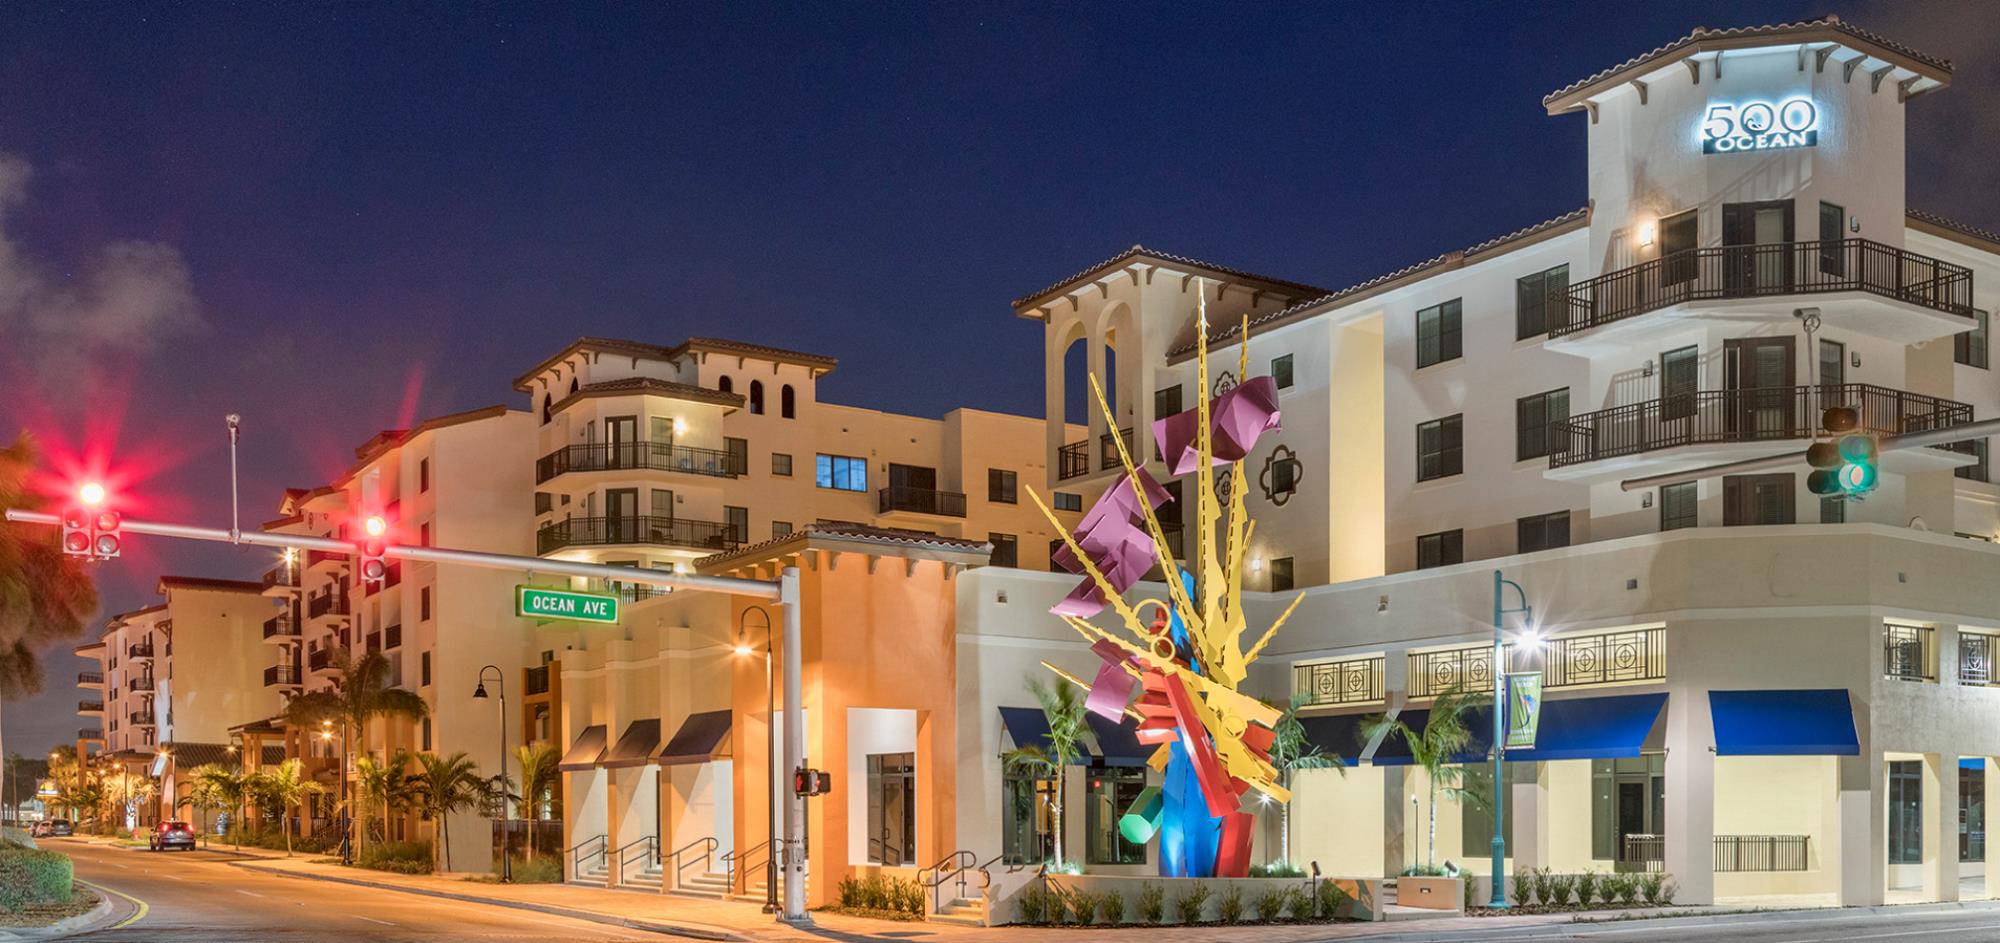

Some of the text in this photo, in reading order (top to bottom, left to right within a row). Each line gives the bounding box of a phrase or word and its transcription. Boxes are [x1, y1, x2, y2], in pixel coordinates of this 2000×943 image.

[1704, 99, 1816, 139] 500
[1715, 132, 1807, 151] OCEAN
[532, 595, 608, 616] OCEAN AVE
